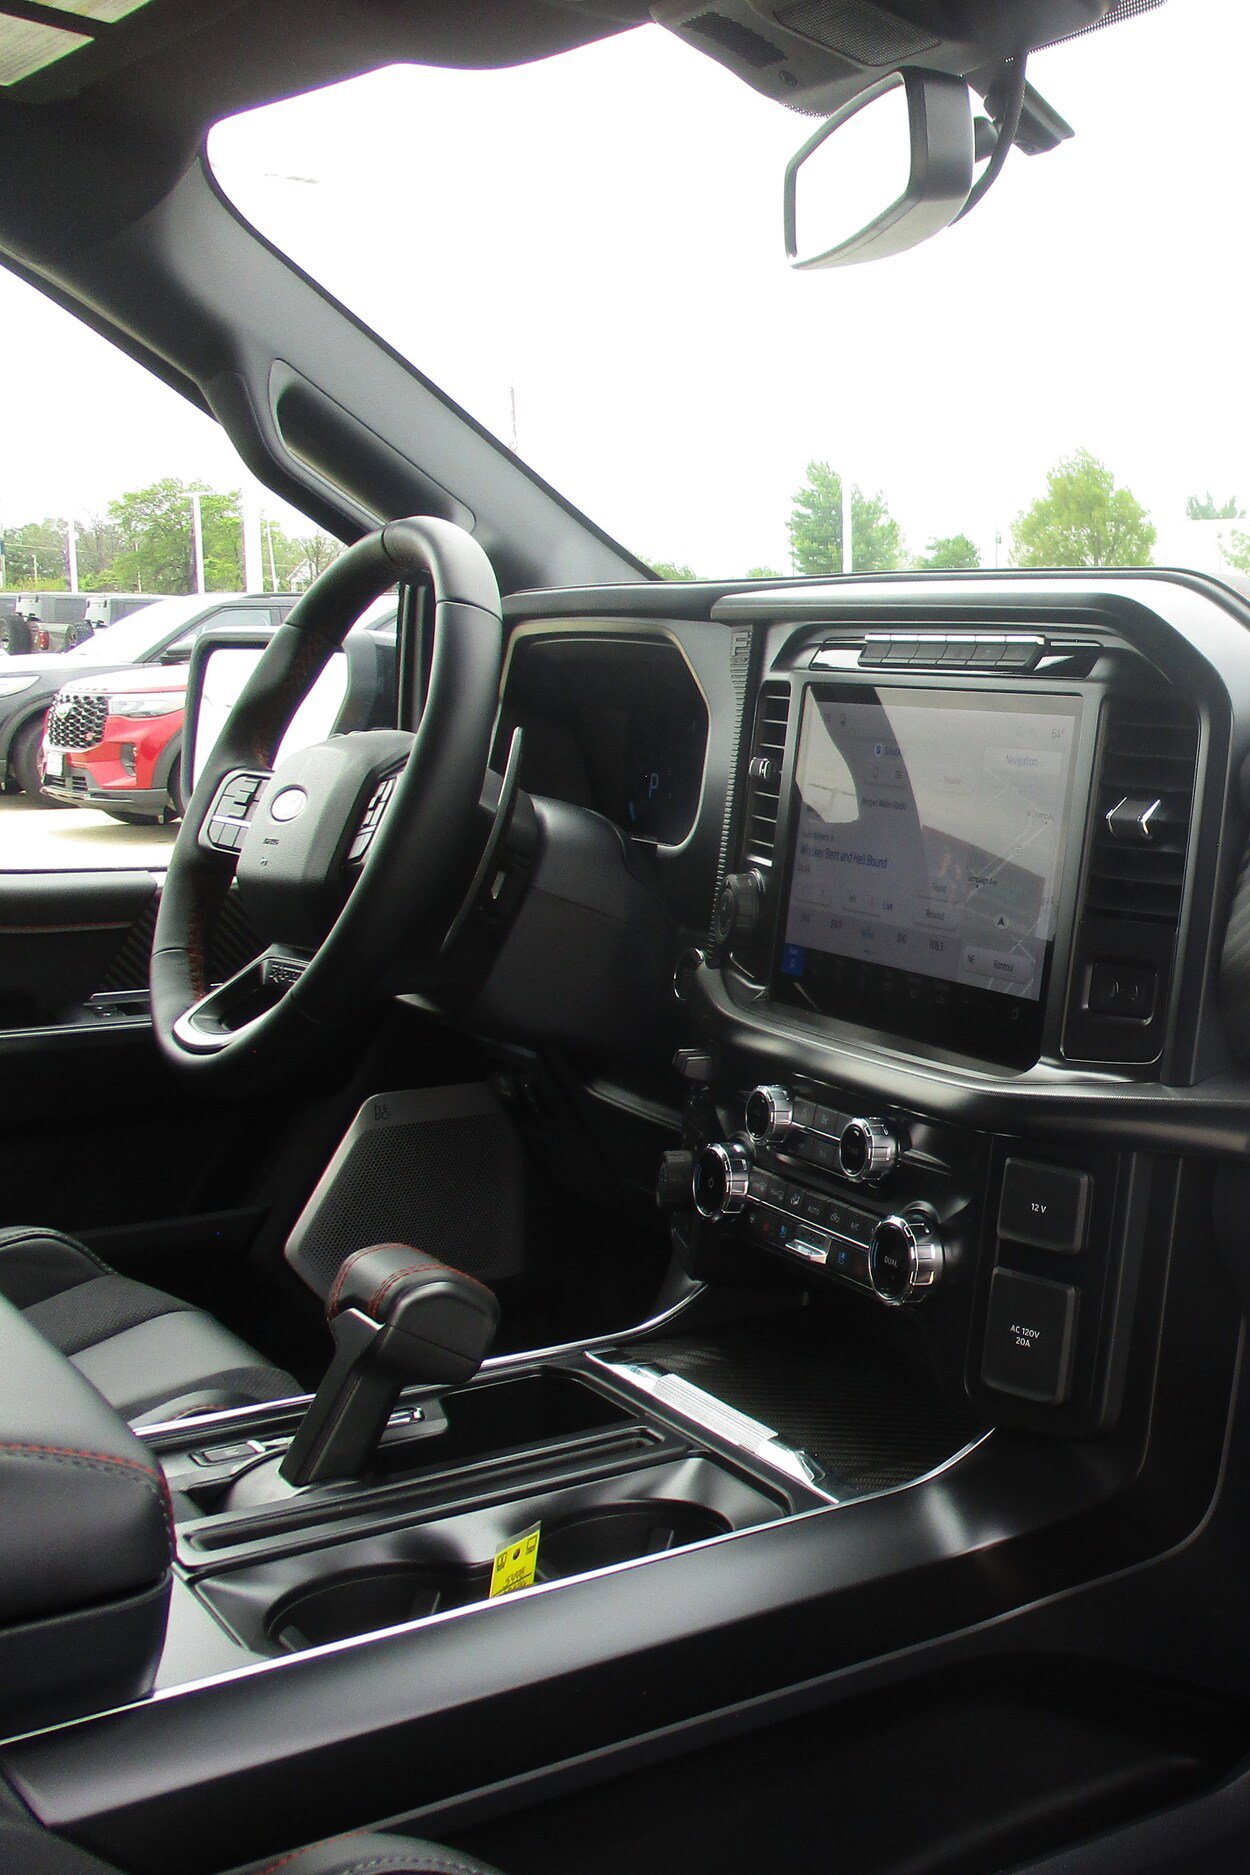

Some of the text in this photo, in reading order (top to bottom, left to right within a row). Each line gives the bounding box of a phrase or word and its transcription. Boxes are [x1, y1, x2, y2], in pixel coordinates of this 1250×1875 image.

[648, 772, 660, 799] P
[807, 1205, 820, 1216] AUTO
[1031, 1203, 1047, 1214] 12 V
[883, 1255, 898, 1268] DUAL
[1010, 1324, 1041, 1340] AC 120V
[1015, 1336, 1031, 1348] 20A
